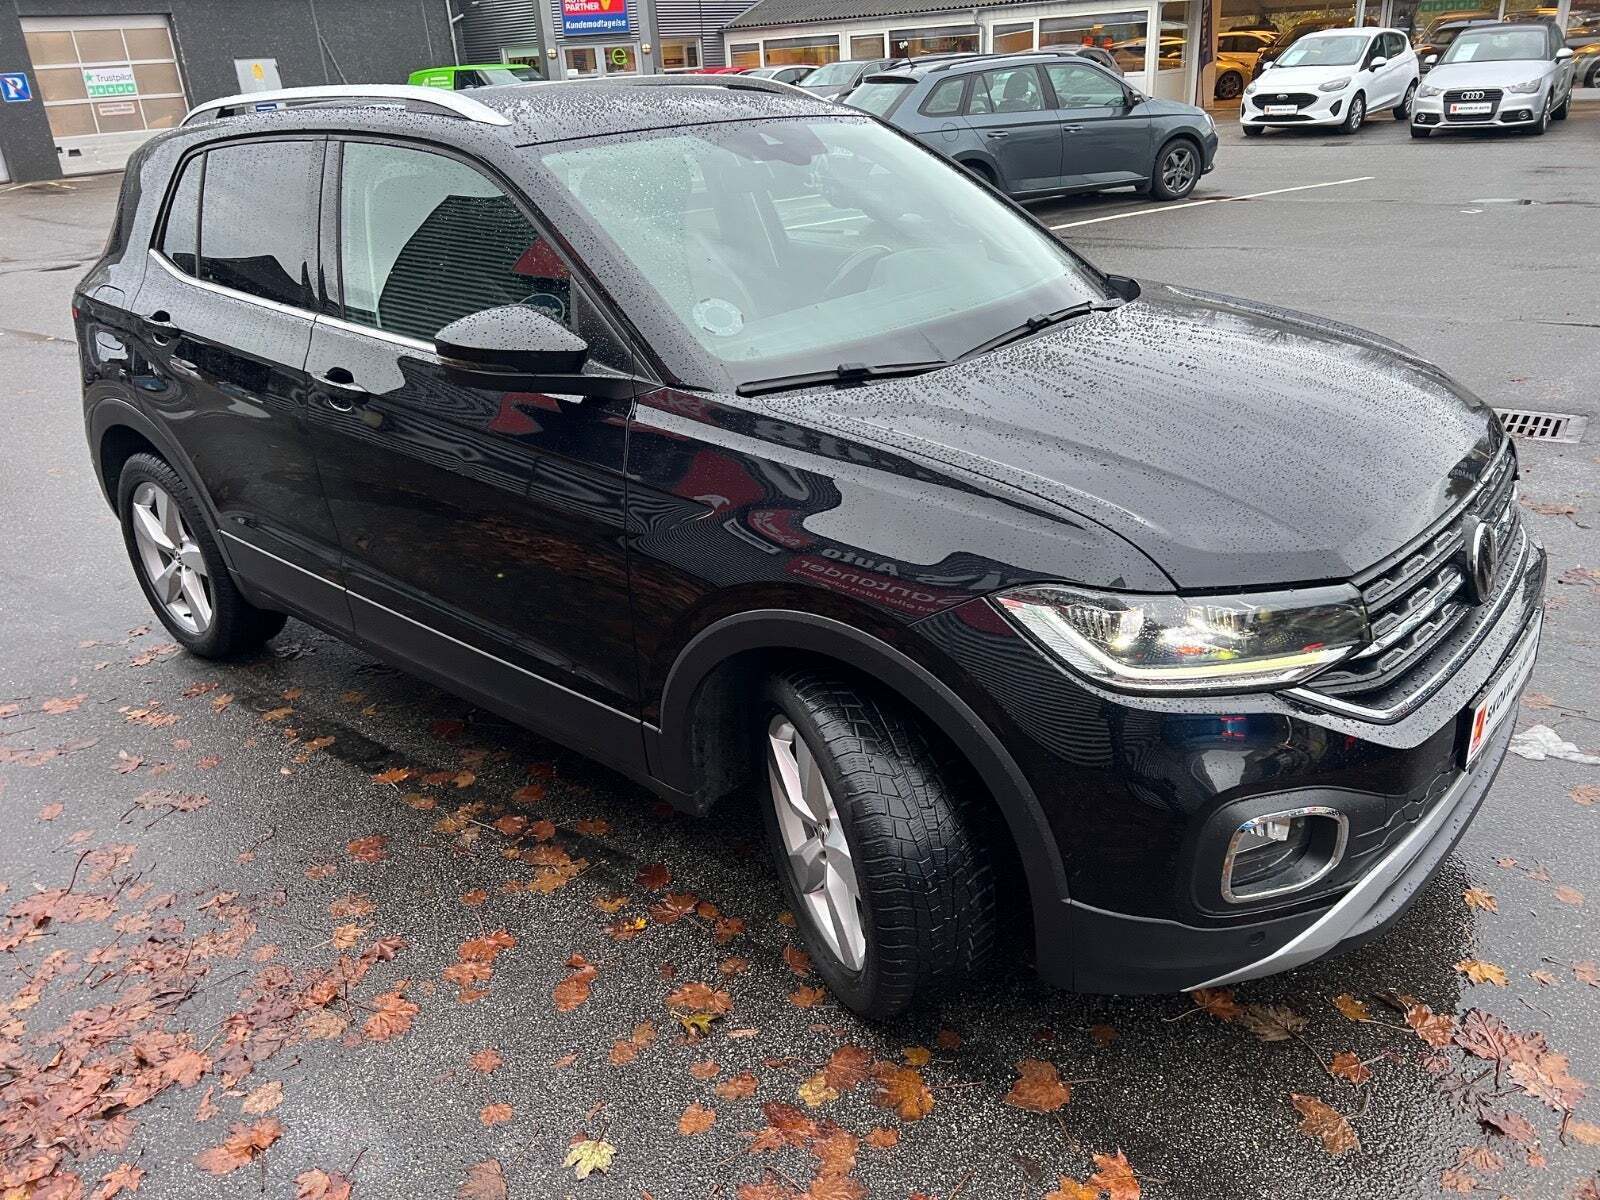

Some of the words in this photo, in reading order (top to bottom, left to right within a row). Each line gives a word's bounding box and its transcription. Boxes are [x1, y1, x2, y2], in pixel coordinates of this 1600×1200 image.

[565, 2, 599, 12] PARTNER
[565, 19, 626, 29] Kundemodtagelse
[96, 73, 132, 82] Trustpilot
[5, 77, 23, 97] P
